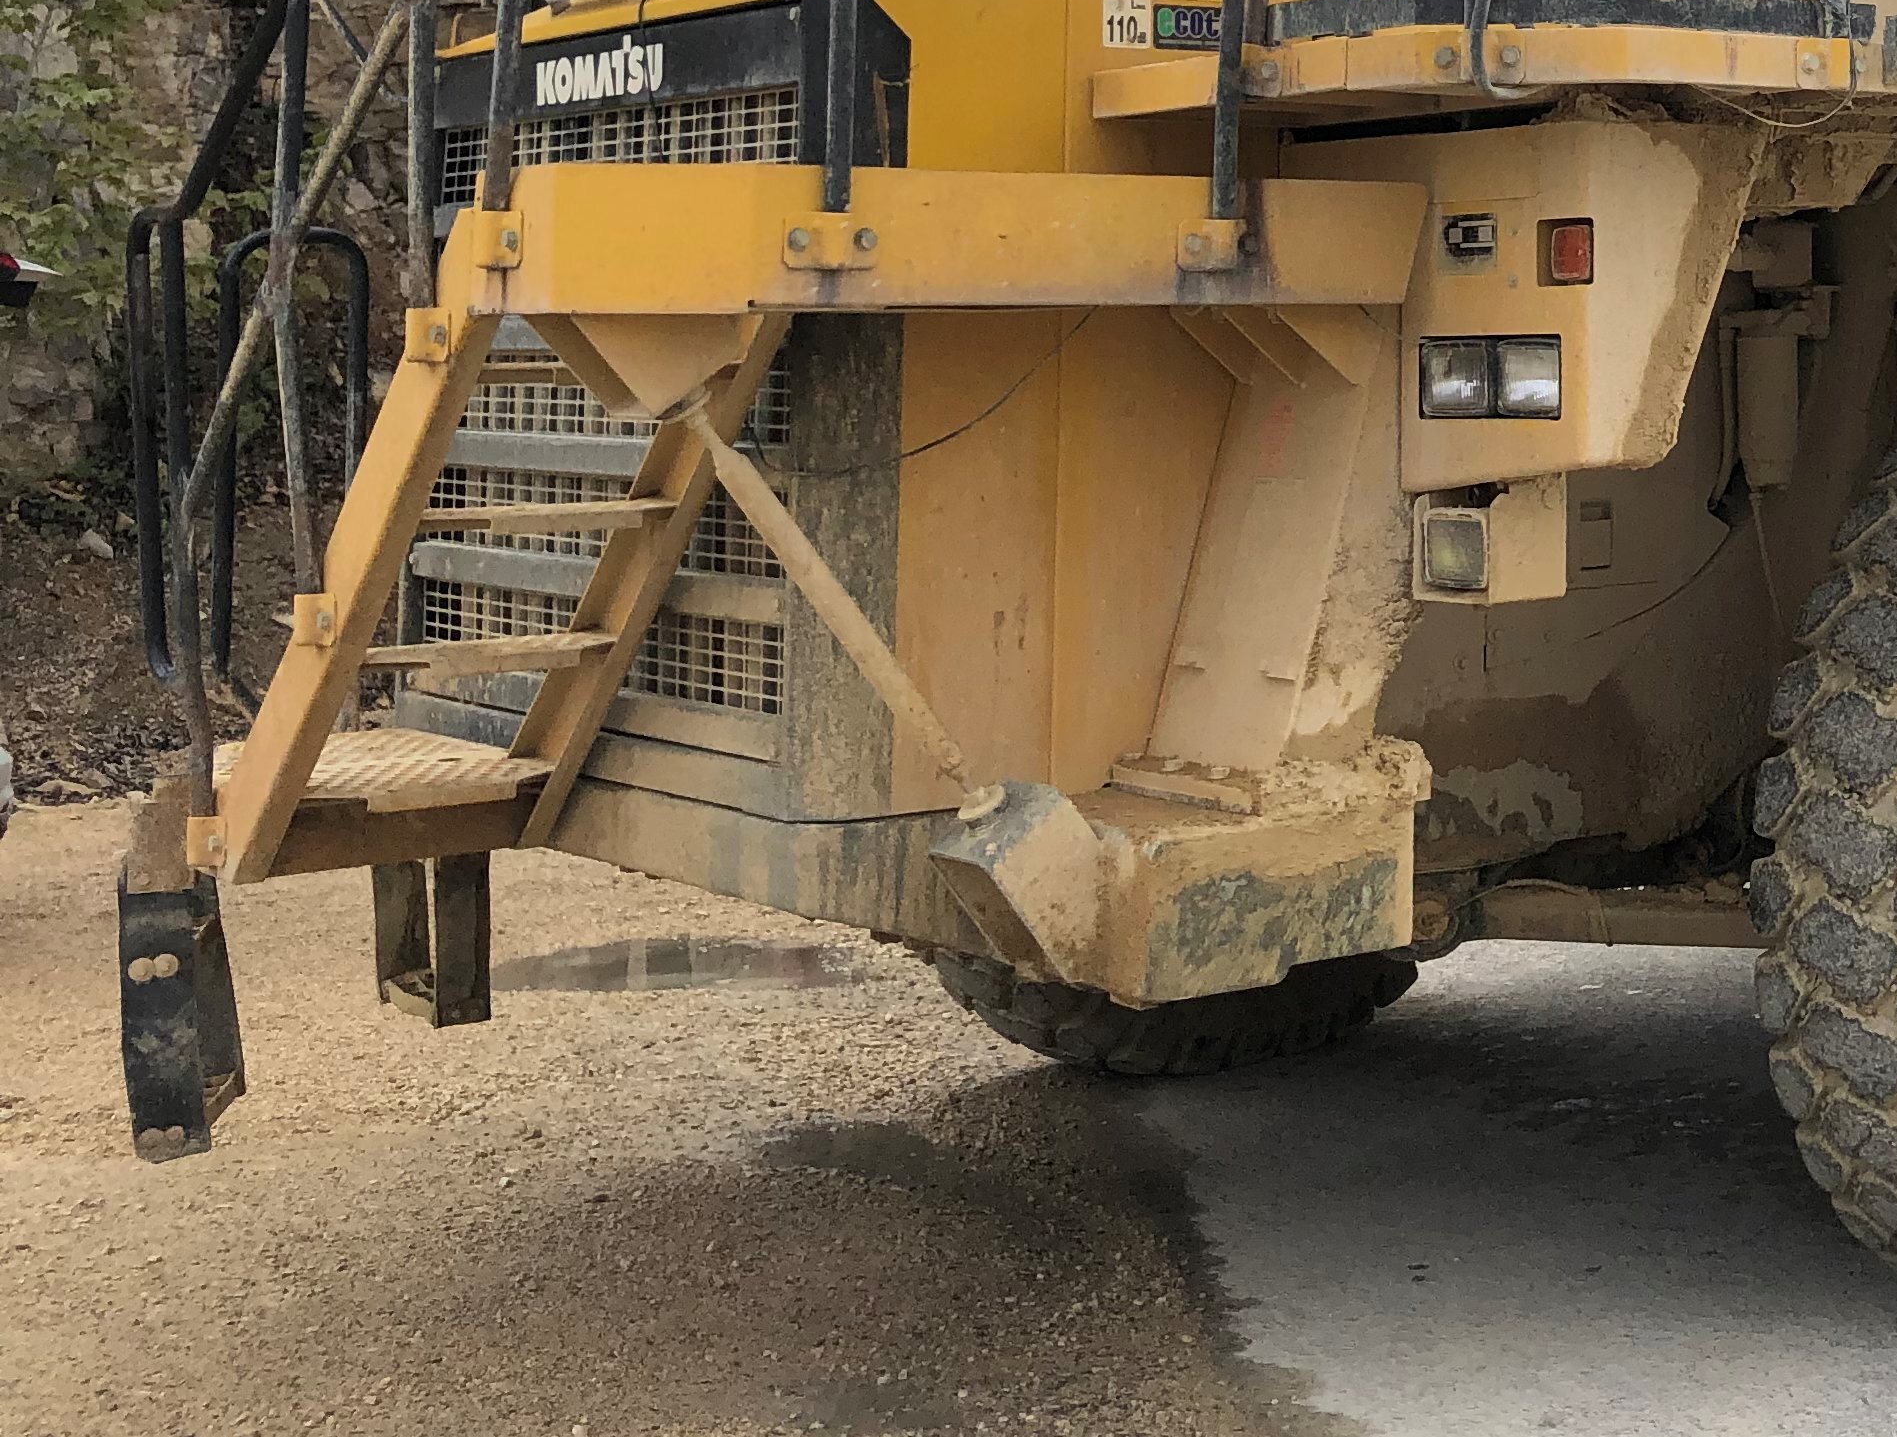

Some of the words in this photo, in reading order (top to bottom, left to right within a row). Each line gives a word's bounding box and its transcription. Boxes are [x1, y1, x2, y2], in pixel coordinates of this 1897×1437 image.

[1106, 15, 1138, 43] 110
[1156, 7, 1222, 39] ecot
[536, 34, 664, 107] KOMATSU
